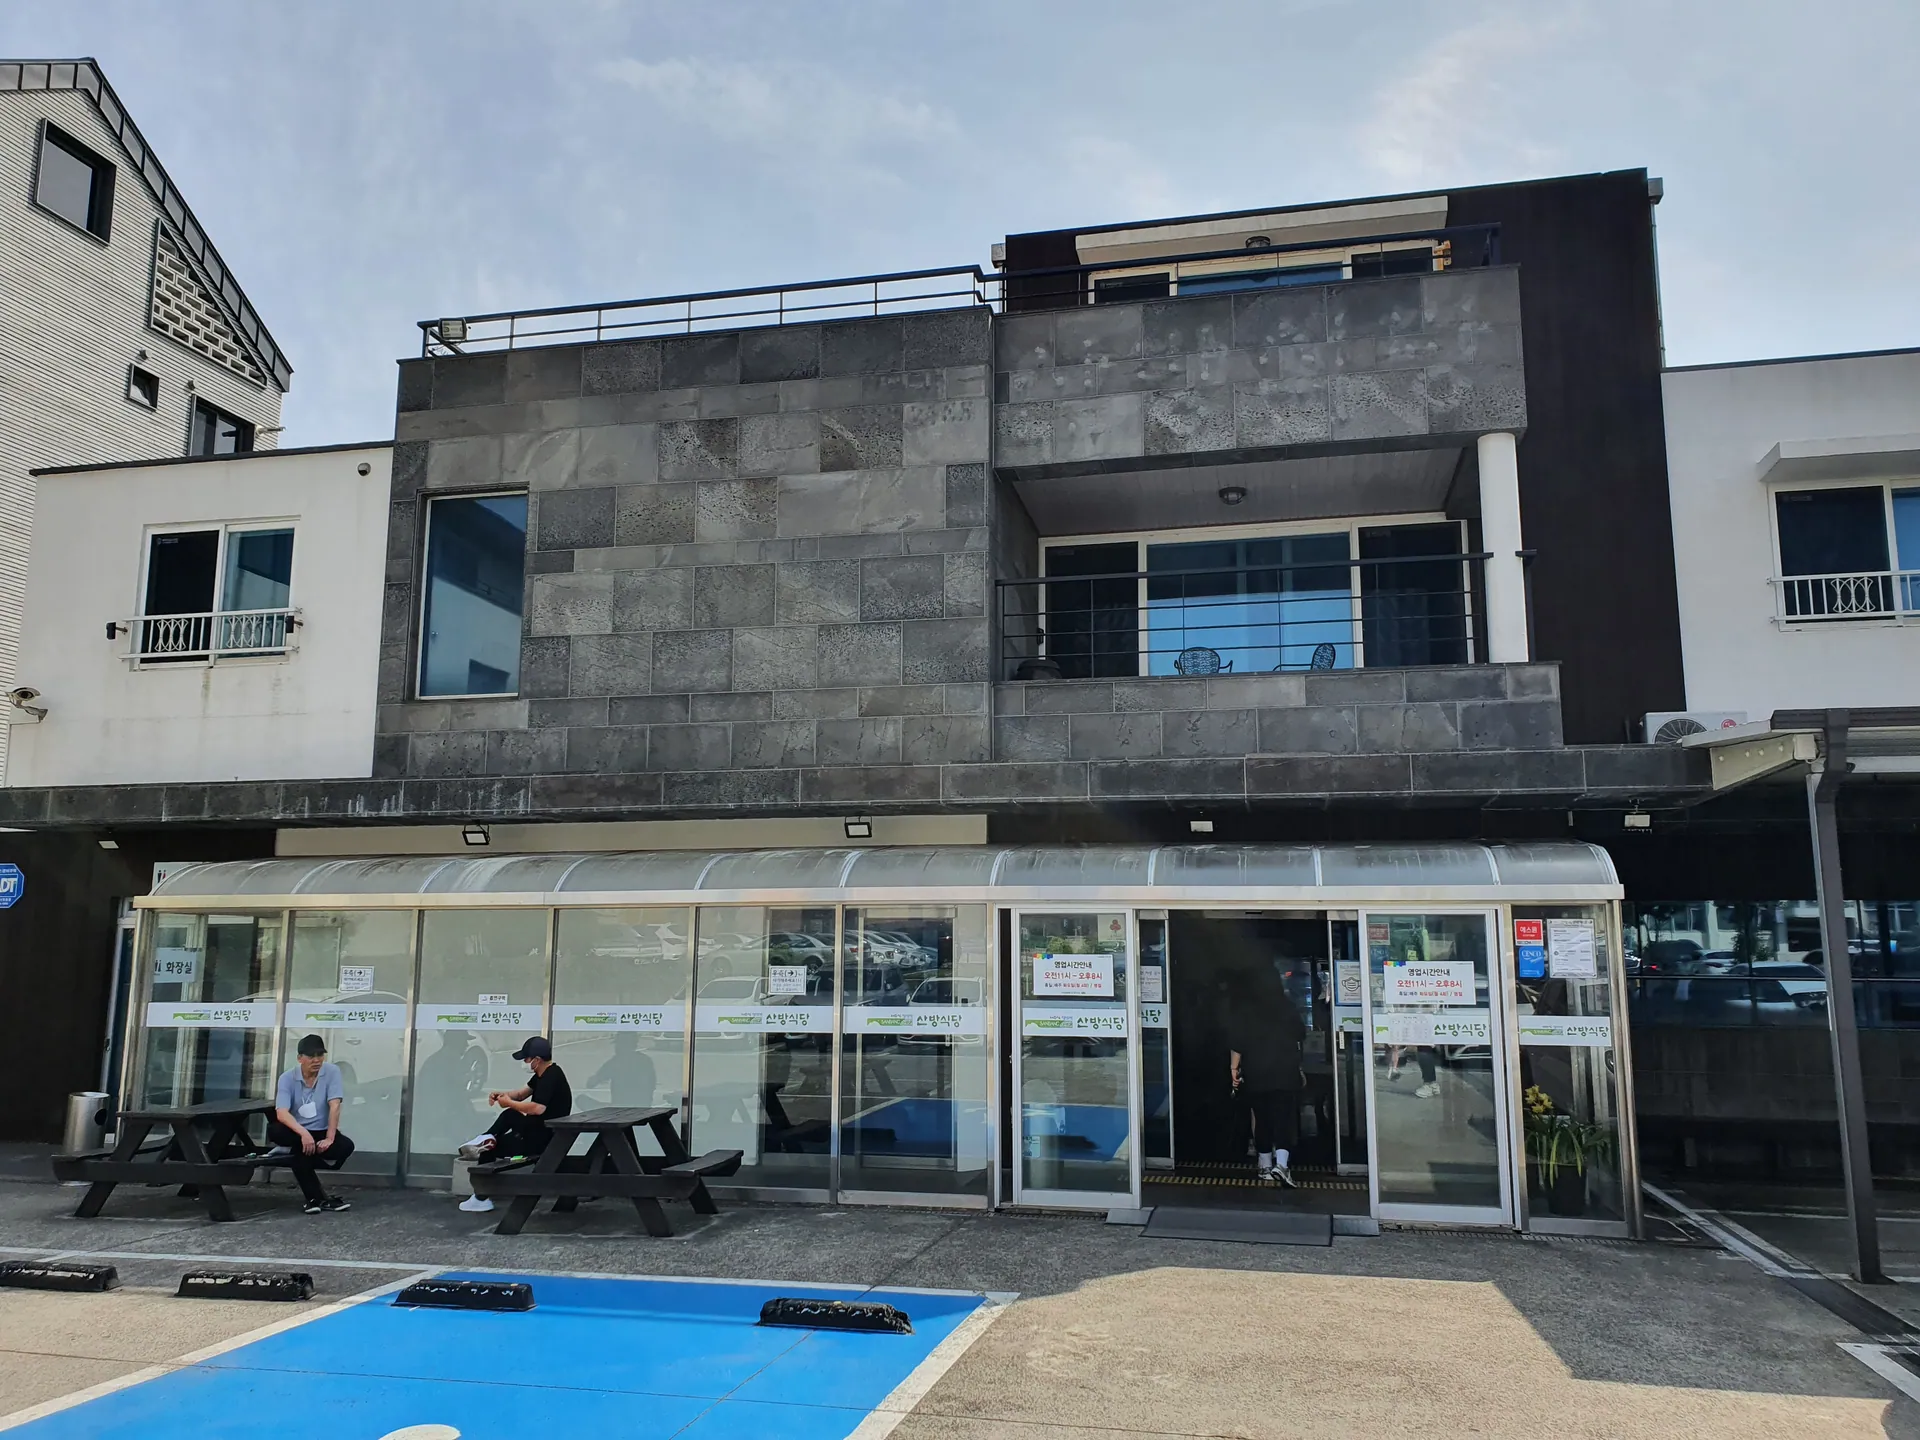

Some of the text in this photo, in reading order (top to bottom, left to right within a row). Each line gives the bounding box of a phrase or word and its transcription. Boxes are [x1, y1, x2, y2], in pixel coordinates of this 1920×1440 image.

[0, 878, 18, 893] DT
[1519, 926, 1538, 934] 에스원
[165, 961, 193, 975] 화장실
[1054, 961, 1092, 969] 영업시간안내
[1044, 972, 1071, 980] 오전11시
[1079, 972, 1103, 980] 오후8시
[1408, 968, 1450, 976] 영업시간안내
[1397, 980, 1427, 988] 오전11시
[1435, 980, 1463, 988] 오후8시
[213, 1010, 251, 1022] 산방식당
[348, 1011, 387, 1023] 산방식당
[481, 1012, 522, 1025] 산방식당
[620, 1012, 663, 1026] 산방식당
[766, 1013, 810, 1026] 산방식당
[916, 1014, 962, 1028] 산방식당
[1076, 1016, 1125, 1030] 산방식당
[1434, 1023, 1487, 1037] 산방식당
[1566, 1026, 1609, 1038] 산방식당
